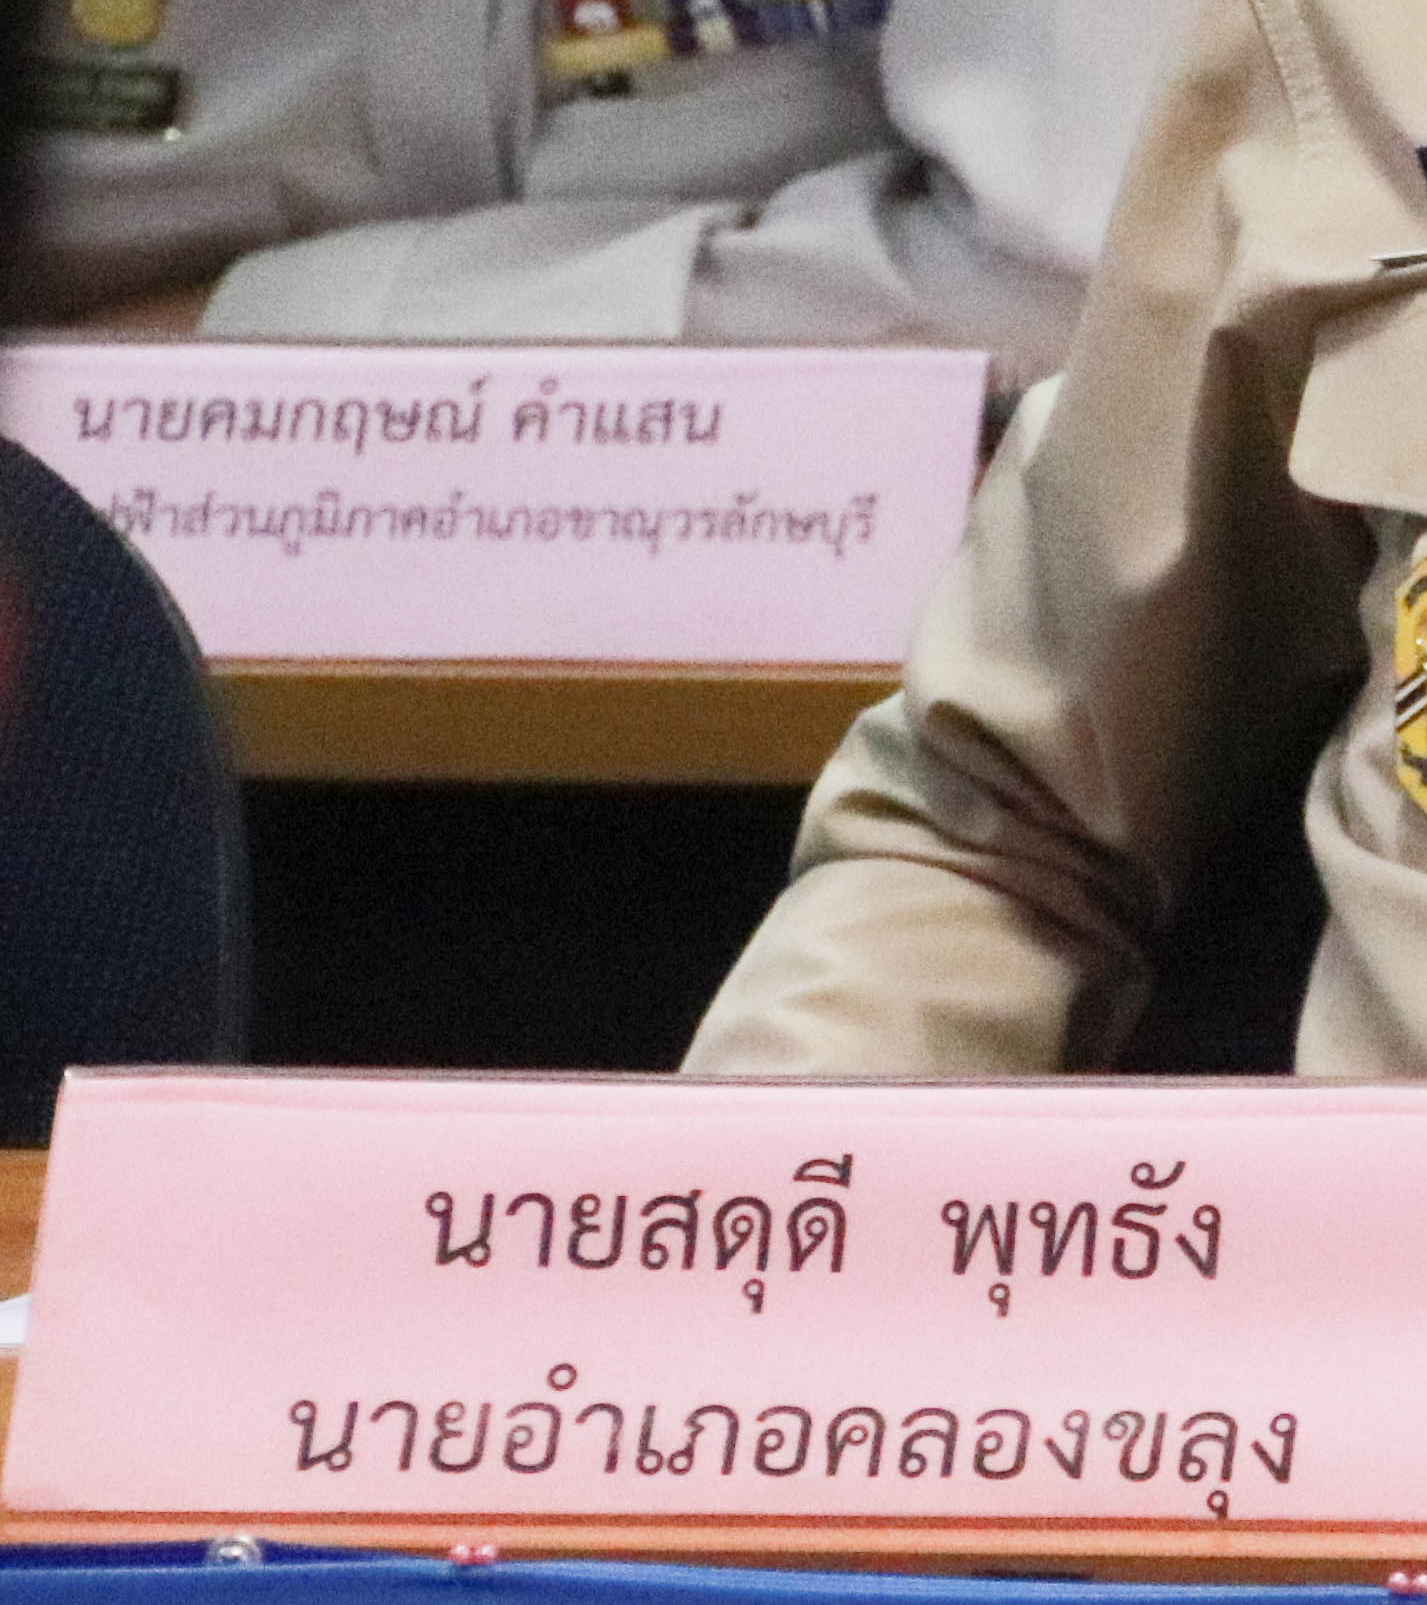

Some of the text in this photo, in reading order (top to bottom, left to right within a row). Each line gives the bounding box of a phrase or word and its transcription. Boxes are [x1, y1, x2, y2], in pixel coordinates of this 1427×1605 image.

[74, 373, 723, 455] นายคมกฤษณ์ คำแสน
[425, 1154, 1222, 1317] นายสดุดี พุทธัง
[289, 1363, 1298, 1519] นายอำเภอคลองขลุง
